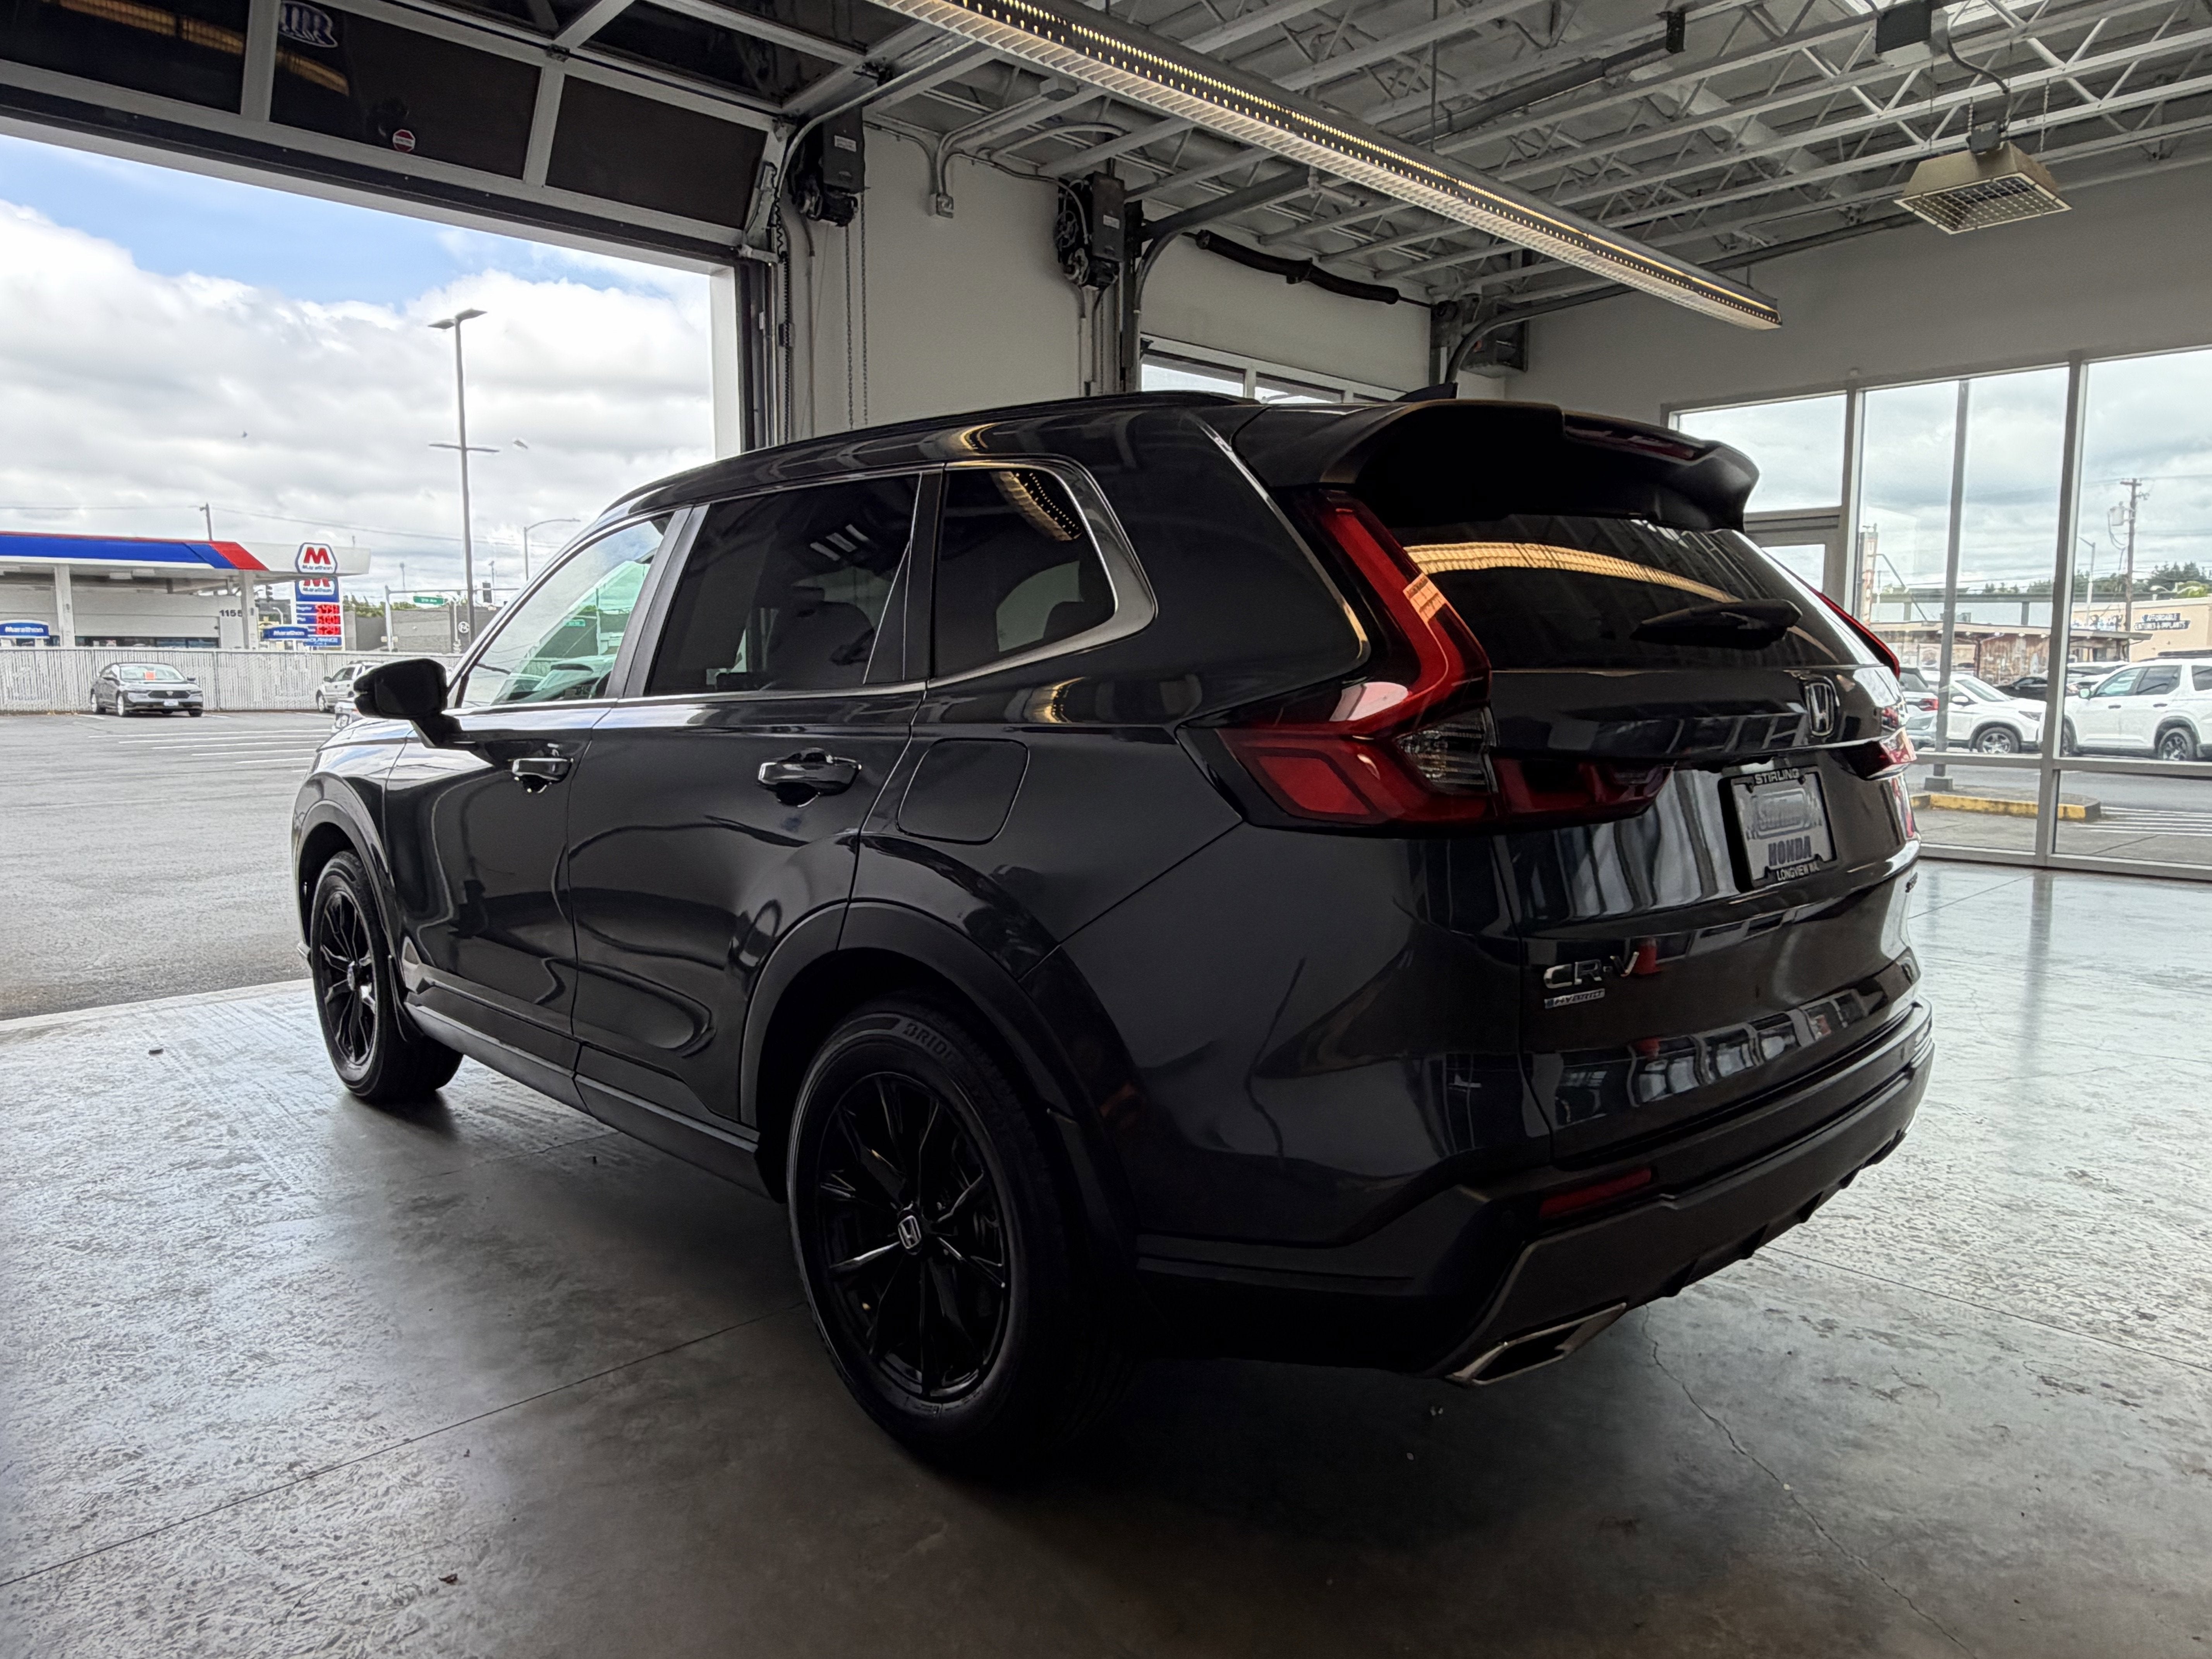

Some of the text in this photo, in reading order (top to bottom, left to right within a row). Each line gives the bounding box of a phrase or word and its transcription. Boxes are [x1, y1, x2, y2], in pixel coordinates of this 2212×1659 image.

[1754, 768, 1800, 784] STIRLING
[1768, 835, 1812, 867] HONDA
[1543, 951, 1640, 989] CR-V
